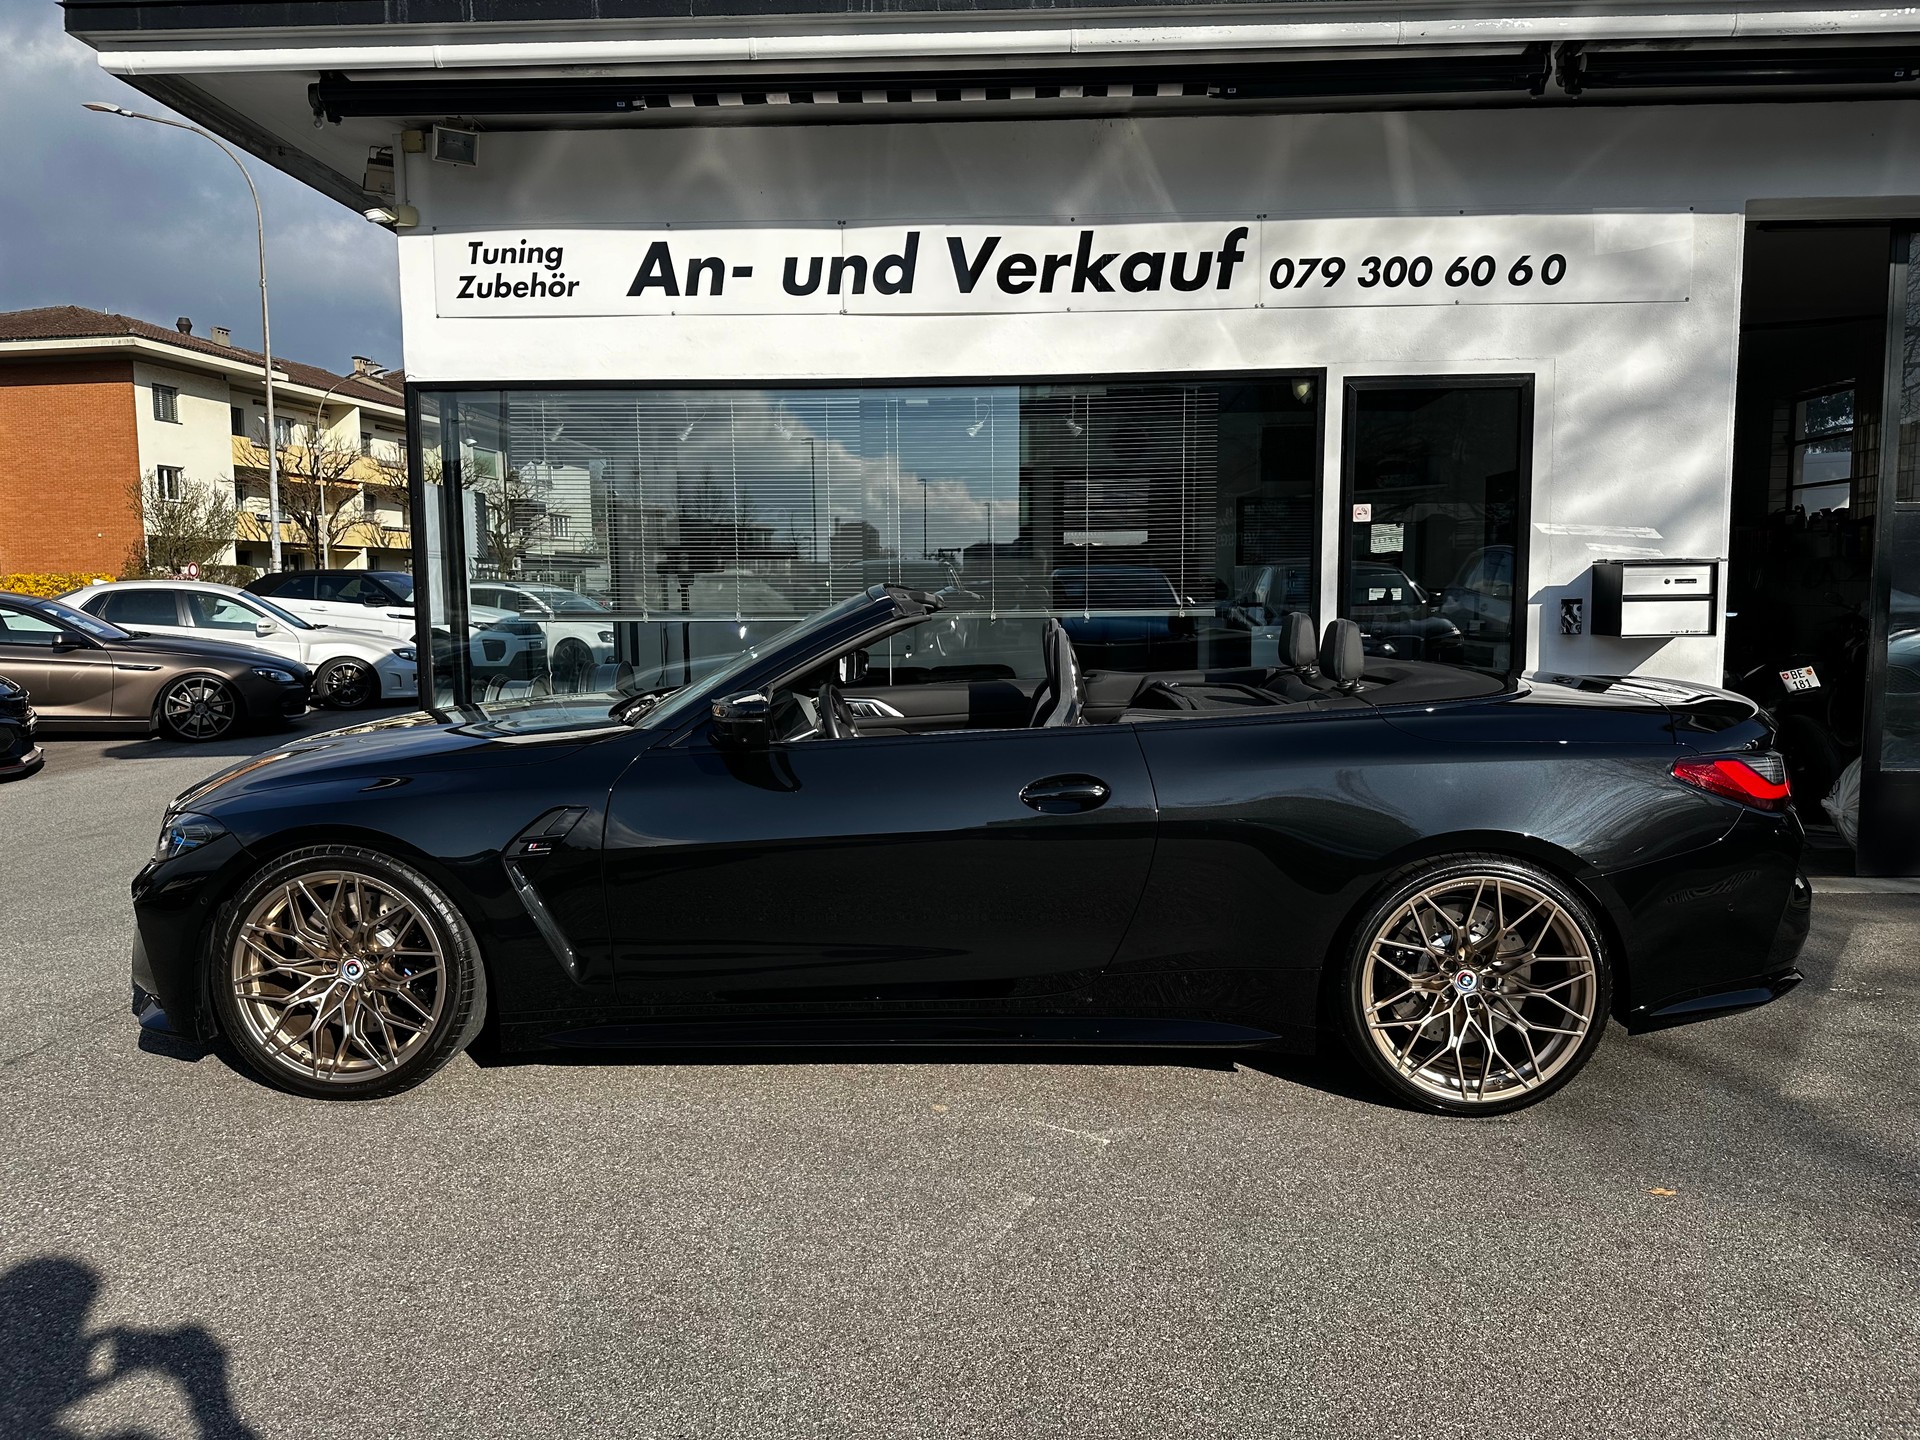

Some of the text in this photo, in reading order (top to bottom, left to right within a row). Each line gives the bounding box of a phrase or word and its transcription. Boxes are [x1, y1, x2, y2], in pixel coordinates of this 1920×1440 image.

[468, 239, 564, 271] Tuning
[626, 227, 1249, 297] An- und Verkauf
[456, 272, 580, 299] Zubehör
[1269, 257, 1346, 290] 079
[1357, 256, 1433, 288] 300
[1445, 255, 1496, 288] 60
[1790, 669, 1805, 679] BE
[1793, 679, 1812, 689] 181
